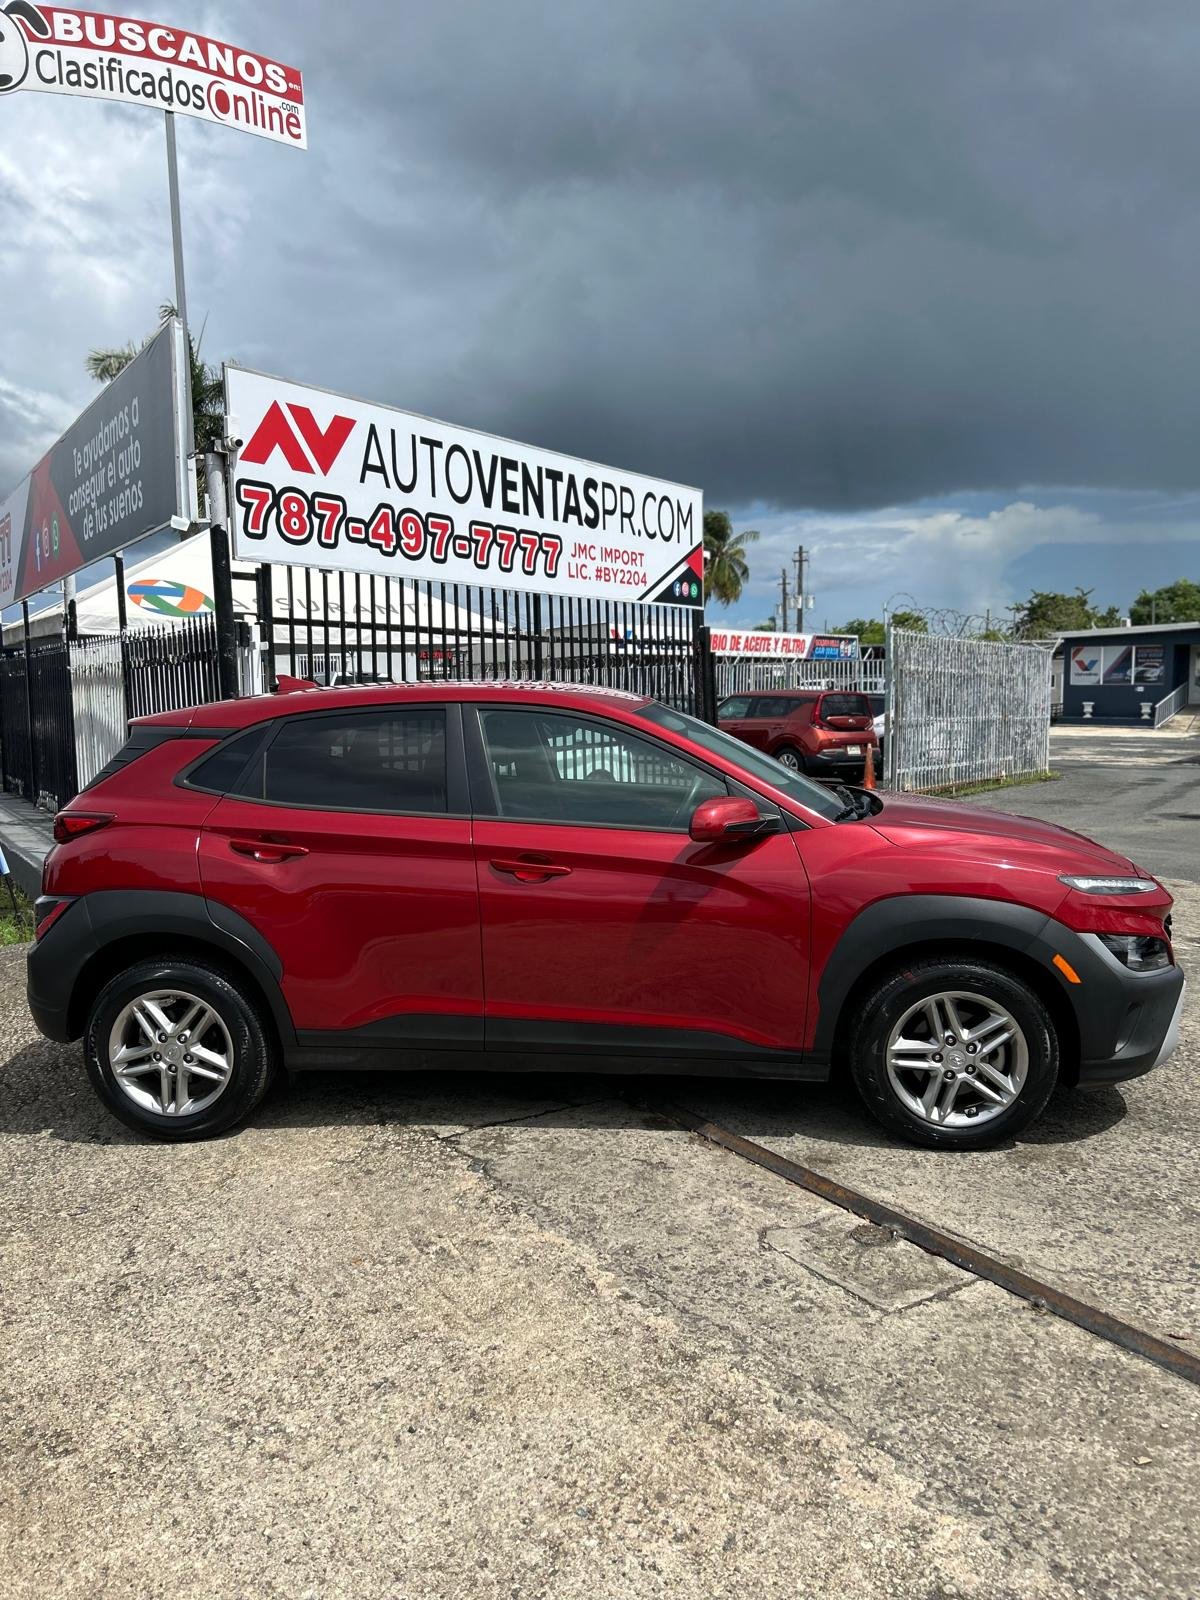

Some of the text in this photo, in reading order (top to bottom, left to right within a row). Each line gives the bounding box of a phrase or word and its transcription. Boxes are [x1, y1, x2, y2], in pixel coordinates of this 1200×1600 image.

[52, 11, 288, 94] BUSCANOS
[279, 102, 299, 115] .com
[73, 396, 139, 478] Te ayudamos a
[69, 435, 141, 516] conseguir el auto
[359, 423, 694, 546] AUTOVENTASPR.COM
[83, 478, 143, 541] de tus sueños
[236, 478, 562, 579] 787-497-7777
[568, 562, 647, 587] LIC. #BY2204
[571, 542, 645, 568] JMC IMPORT
[232, 597, 416, 614] ASURANT
[710, 633, 727, 651] BIO
[729, 635, 742, 651] DE
[743, 636, 772, 652] ACEITE
[774, 637, 780, 653] Y
[781, 637, 806, 654] FILTRO
